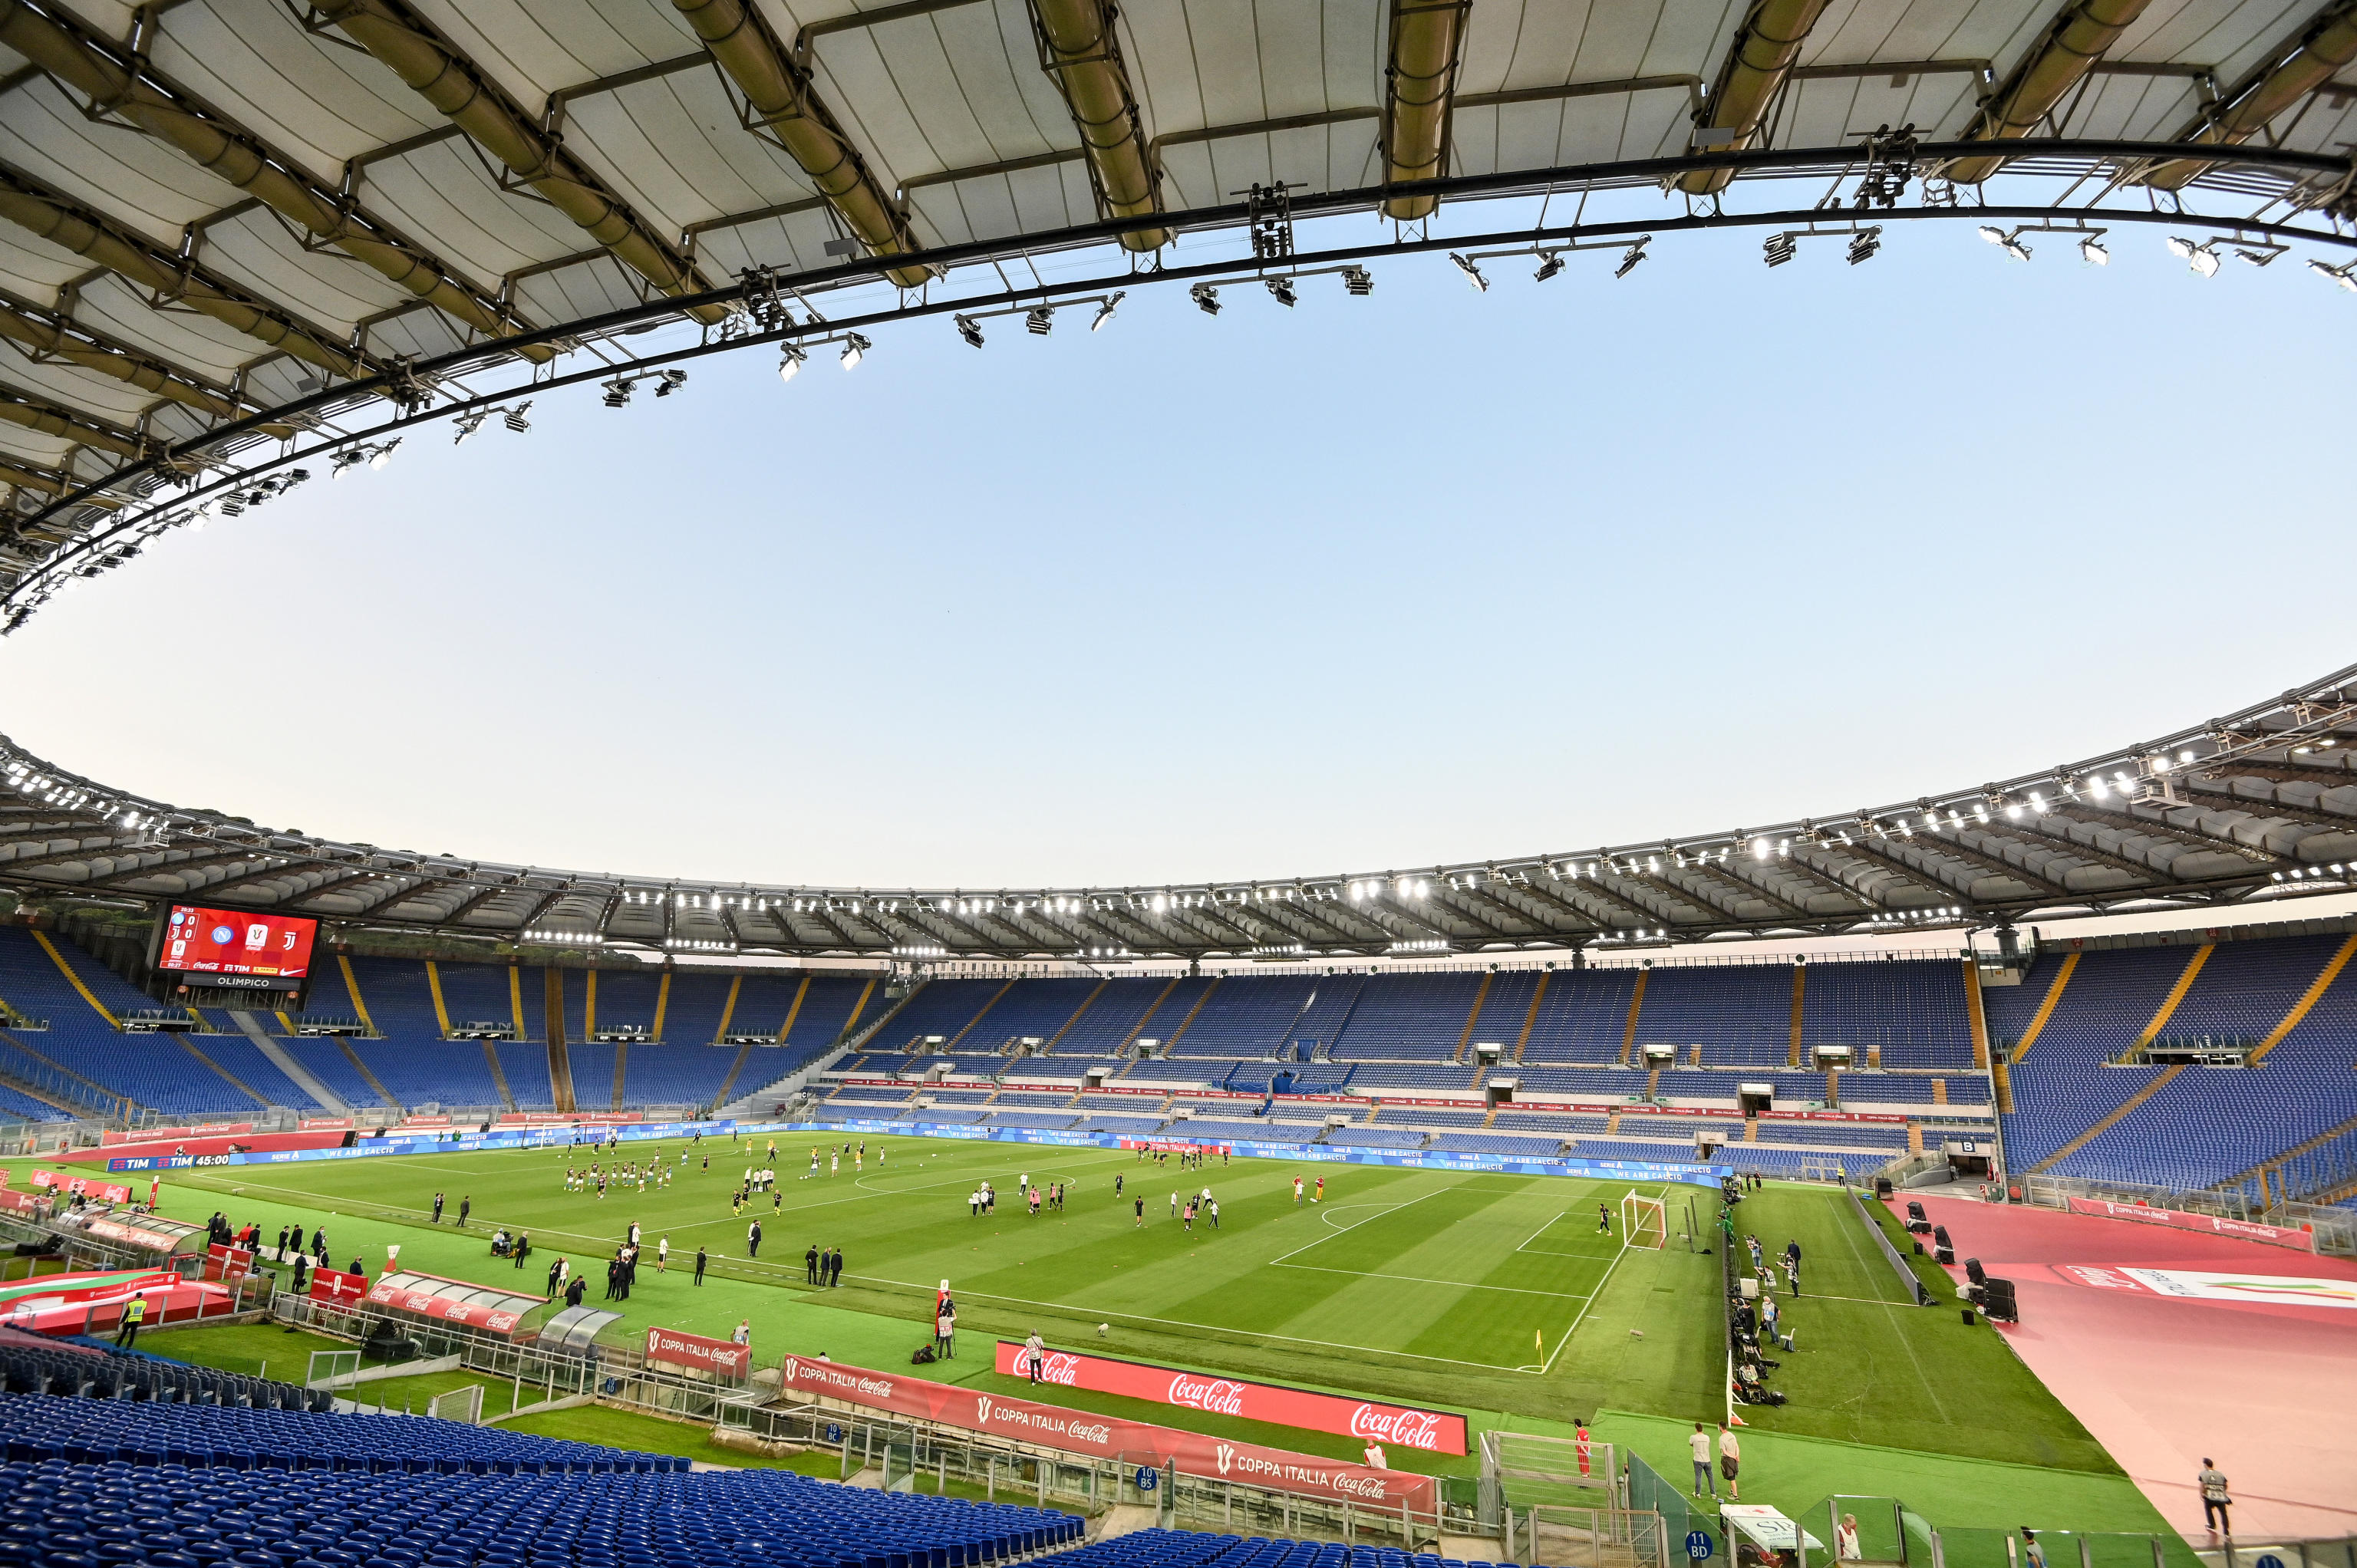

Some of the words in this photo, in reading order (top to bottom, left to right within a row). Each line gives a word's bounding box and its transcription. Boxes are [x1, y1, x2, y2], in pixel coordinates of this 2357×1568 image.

[188, 916, 195, 925] 0
[185, 929, 192, 939] 0
[193, 962, 220, 970] Coca-Cola
[217, 977, 269, 987] OLIMPICO
[1964, 1142, 1973, 1151] B
[291, 1150, 299, 1159] A
[127, 1159, 149, 1169] TIM
[171, 1157, 192, 1166] TIM
[196, 1155, 229, 1166] 45:00
[2116, 1206, 2132, 1215] COPPA
[2151, 1210, 2169, 1220] Coca-Cola
[2222, 1222, 2239, 1231] COPPA
[2240, 1225, 2257, 1234] ITALIA
[2258, 1227, 2277, 1238] Coca-Cola
[370, 1287, 395, 1302] Coca-Cola
[406, 1295, 433, 1311] Coca-Cola
[445, 1304, 473, 1320] Coca-Cola
[487, 1313, 515, 1330] Coca-Cola
[661, 1338, 685, 1354] COPPA
[686, 1344, 709, 1358] ITALIA
[710, 1348, 739, 1366] Coca-Cola
[800, 1366, 826, 1382] COPPA
[828, 1372, 856, 1388] ITALIA
[858, 1377, 893, 1398] Coca-Cola
[1168, 1373, 1246, 1416] Coca-Cola
[995, 1407, 1029, 1426] COPPA
[1032, 1414, 1065, 1433] ITALIA
[1068, 1421, 1111, 1444] Coca-Cola
[1351, 1404, 1441, 1449] Coca-Cola
[828, 1432, 837, 1441] BC
[1142, 1467, 1152, 1478] 10
[1238, 1457, 1282, 1477] COPPA
[1285, 1466, 1329, 1486] ITALIA
[1333, 1473, 1387, 1499] Coca-Cola
[1692, 1533, 1704, 1544] 11
[1691, 1546, 1708, 1558] BD
